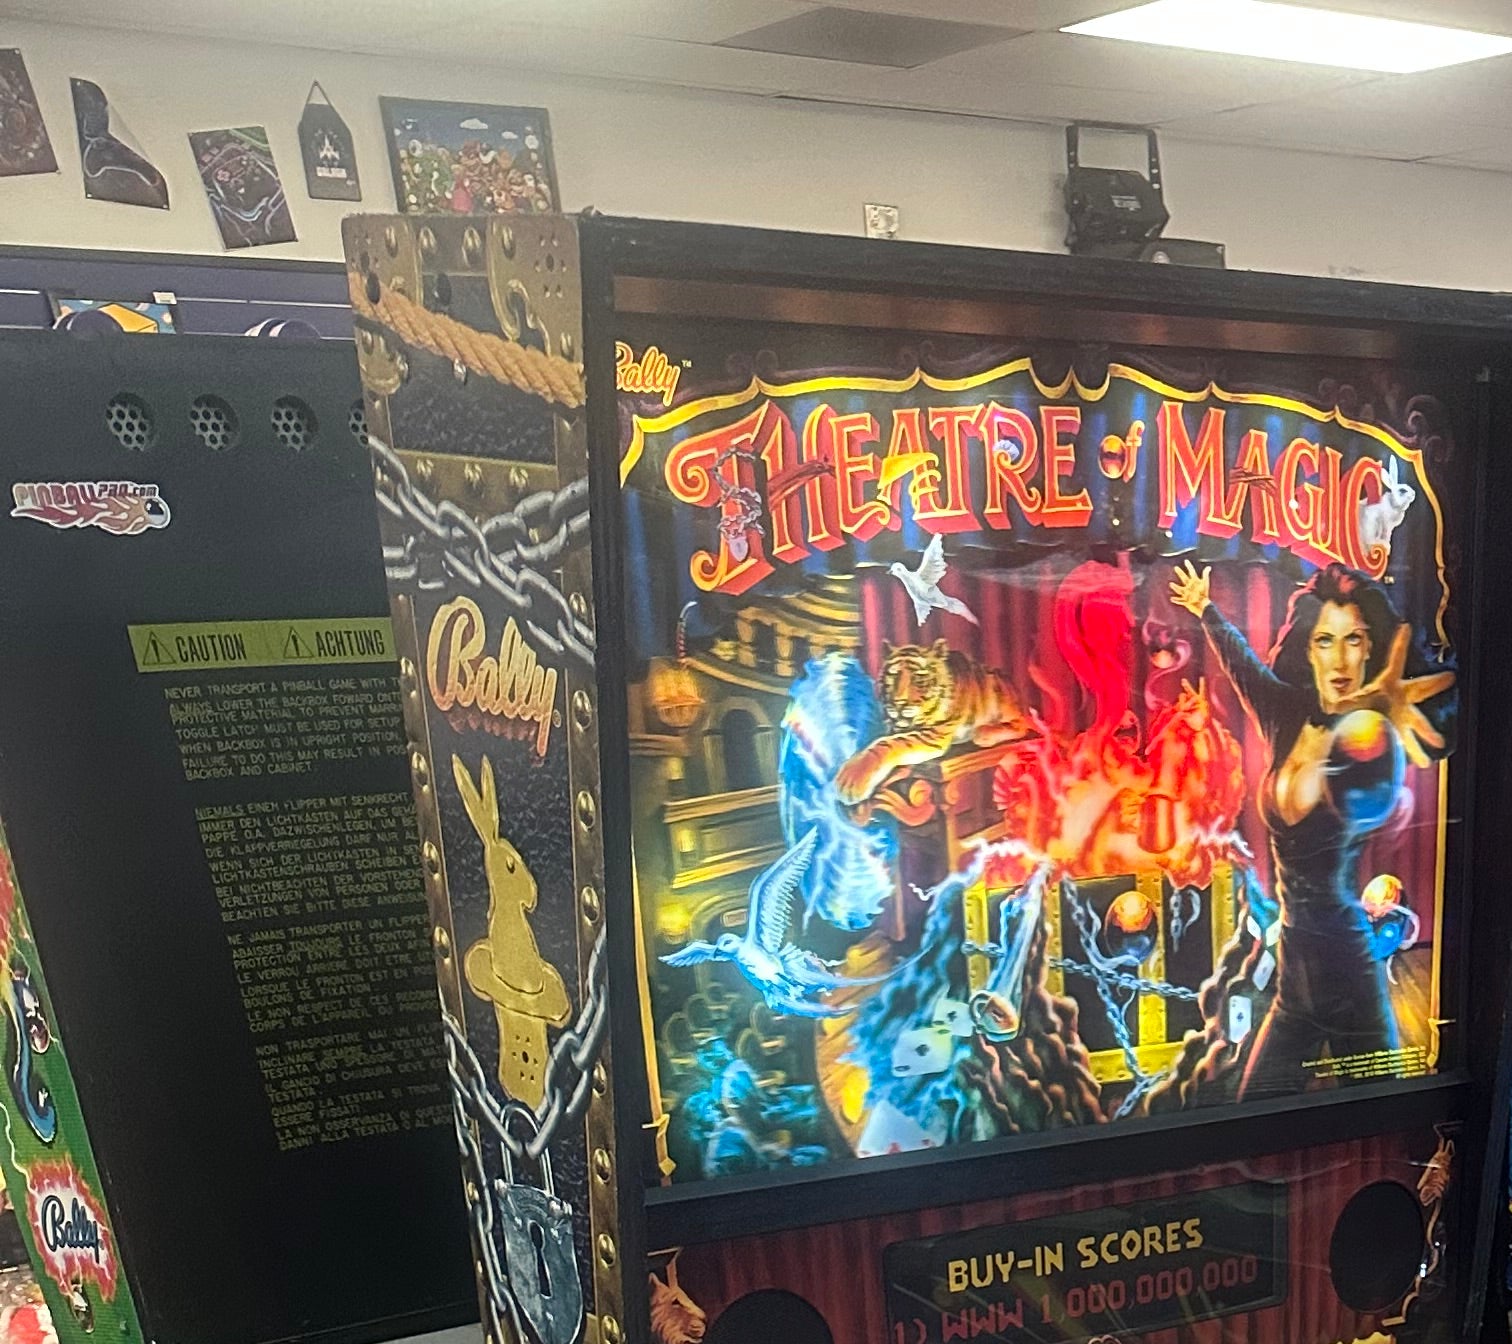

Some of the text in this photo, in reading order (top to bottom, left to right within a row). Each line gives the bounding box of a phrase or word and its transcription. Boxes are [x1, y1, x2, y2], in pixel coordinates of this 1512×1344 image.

[665, 398, 1095, 598] THEATRE
[1155, 398, 1388, 582] MAGIC
[176, 629, 385, 663] CAUTION ACHTUNG
[165, 678, 386, 699] NEVER TRANSPORT A PINBALL GAME WITH
[428, 596, 560, 764] Bally
[217, 696, 327, 712] LOWER THE BACKBOX
[243, 709, 294, 721] MATERIAL
[300, 708, 313, 716] TO
[320, 705, 365, 714] PREVENT
[176, 719, 363, 740] TOGGLE MUST BE USED FOR
[182, 734, 346, 753] WHEN BACKBOX IS IN UPRIGHT
[183, 746, 379, 768] FAILURE TO DO THIS MAY RESULT IN
[186, 766, 262, 780] BACKBOX AND
[240, 818, 260, 828] DEN
[202, 832, 236, 843] PAPPE
[207, 848, 224, 857] DIE
[210, 861, 242, 871] WENN
[249, 858, 273, 868] SICH
[282, 855, 300, 865] DER
[334, 875, 353, 884] DER
[284, 905, 299, 914] SIE
[40, 1194, 105, 1267] Bally
[948, 1217, 1204, 1293] BUY-IN SCORES
[941, 1299, 1024, 1344] WWW
